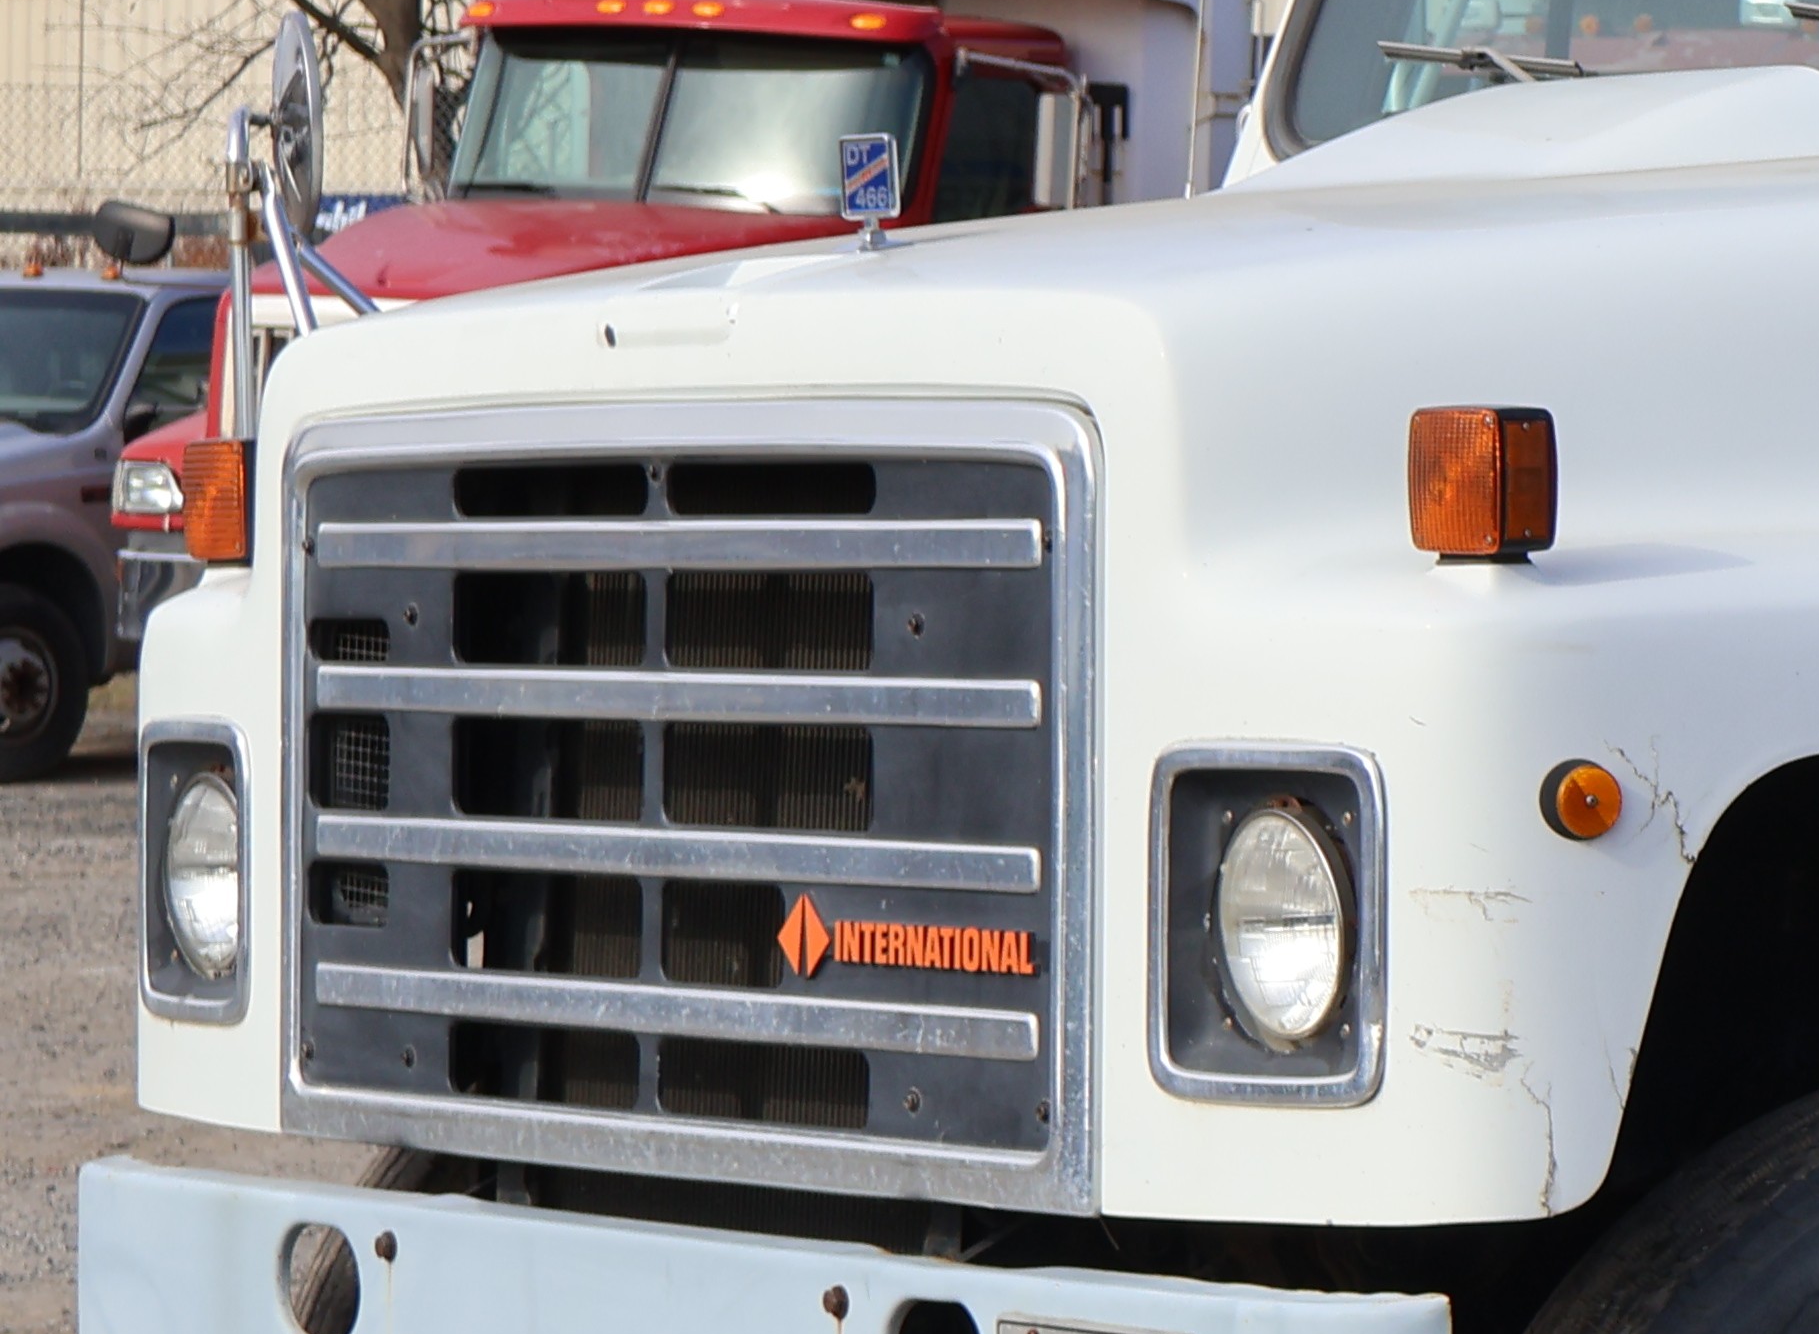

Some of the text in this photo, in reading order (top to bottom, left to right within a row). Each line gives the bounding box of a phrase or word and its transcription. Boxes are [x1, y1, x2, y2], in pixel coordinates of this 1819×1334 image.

[847, 144, 871, 167] DT
[856, 186, 889, 208] 466
[834, 920, 1037, 976] INTERNATIONAL
